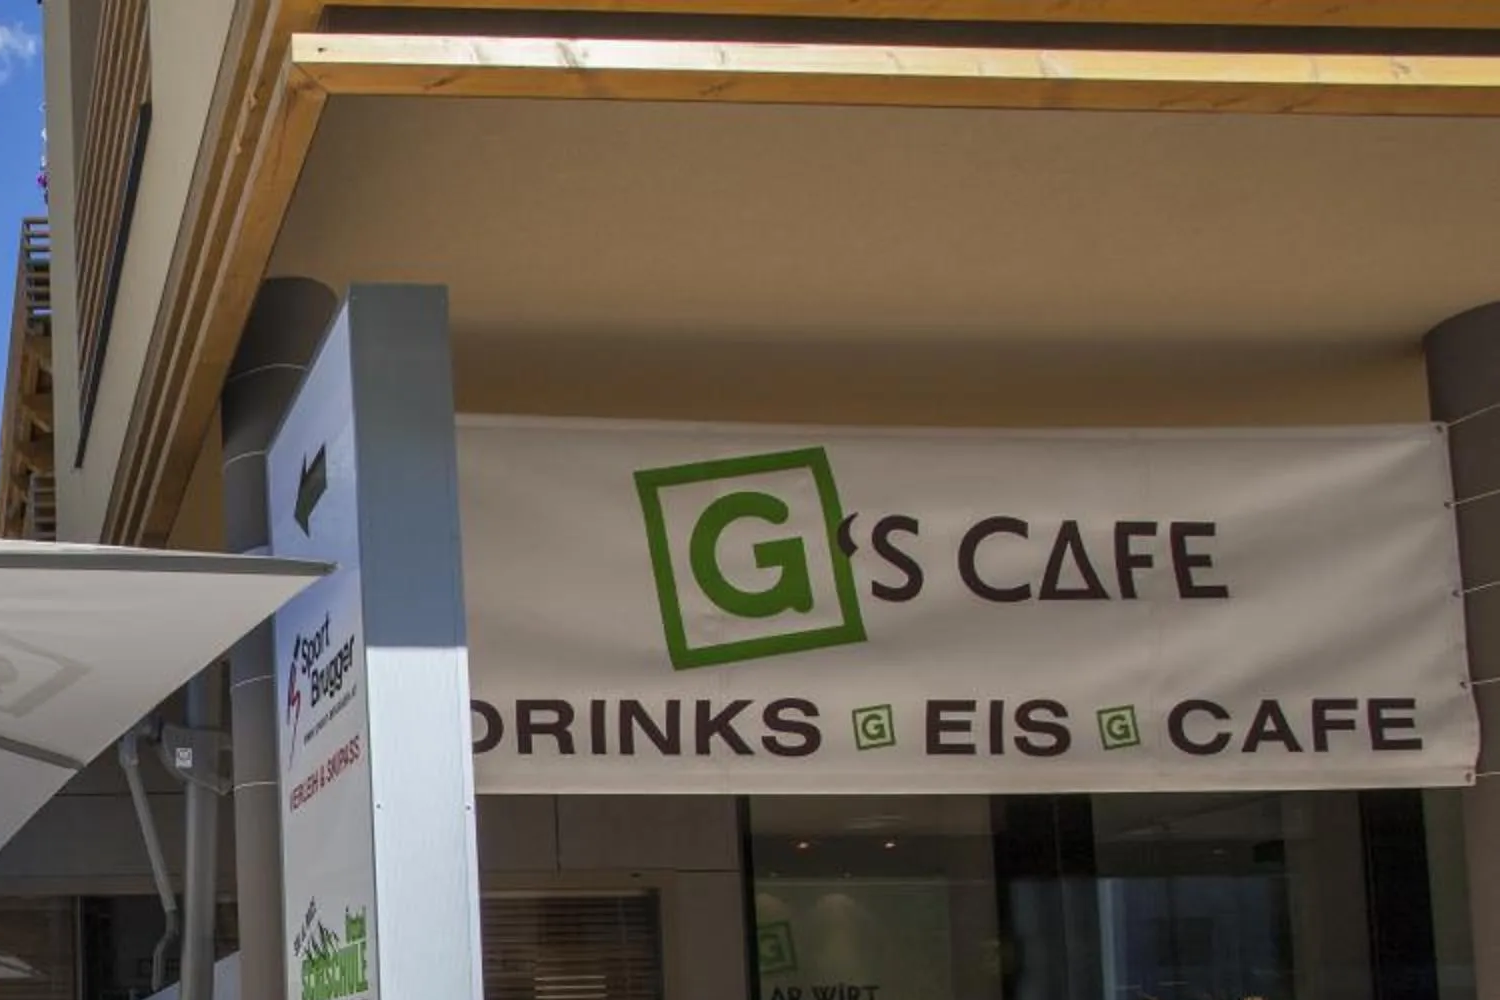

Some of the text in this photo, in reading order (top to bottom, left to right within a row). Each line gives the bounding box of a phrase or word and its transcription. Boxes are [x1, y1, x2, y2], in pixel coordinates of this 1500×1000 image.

[957, 514, 1230, 603] CAFE
[301, 611, 330, 679] Sport
[311, 635, 356, 708] Brugger
[925, 699, 1072, 757] EIS
[1167, 698, 1424, 756] CAFE
